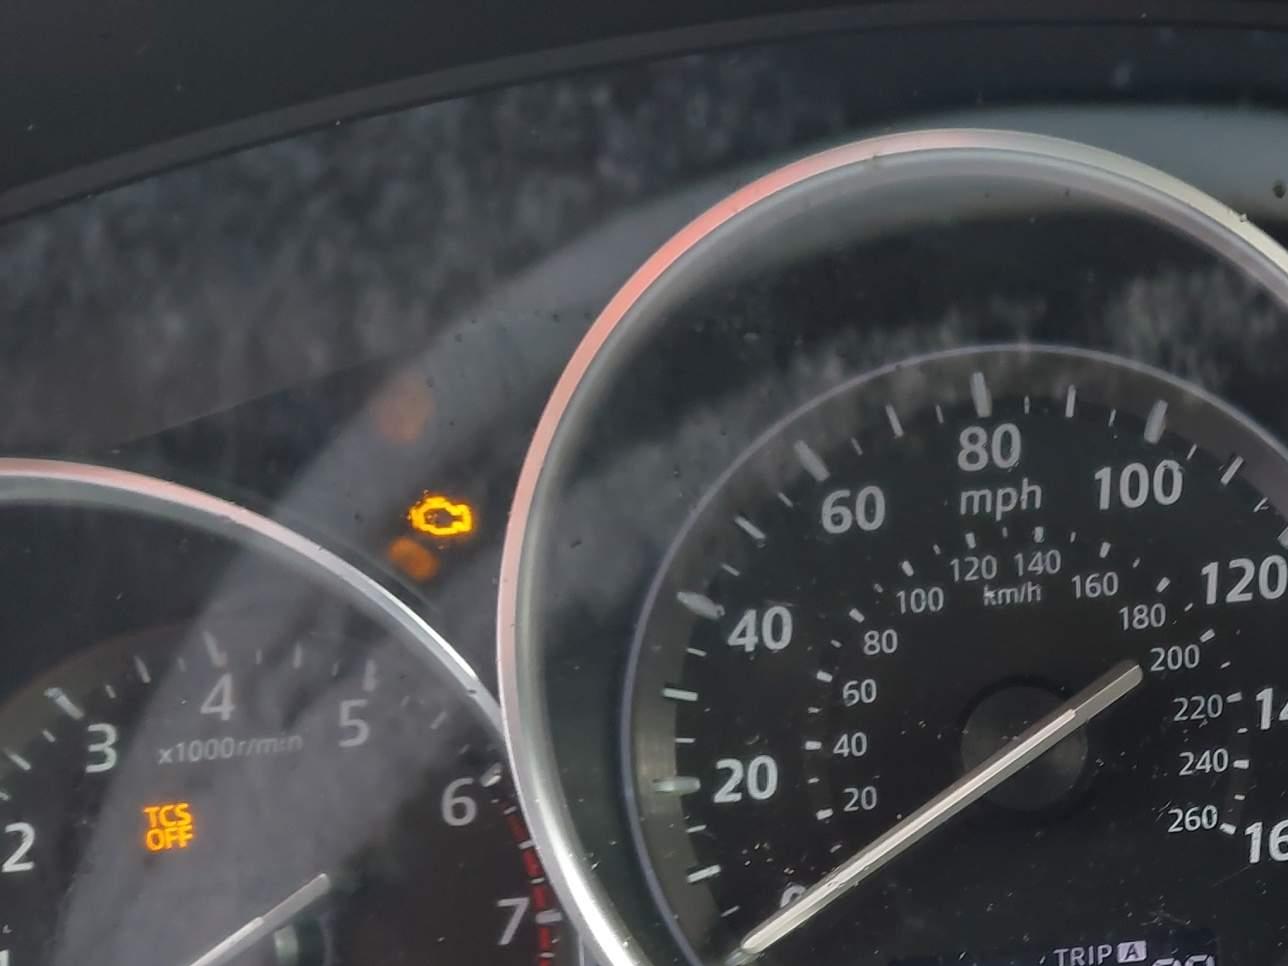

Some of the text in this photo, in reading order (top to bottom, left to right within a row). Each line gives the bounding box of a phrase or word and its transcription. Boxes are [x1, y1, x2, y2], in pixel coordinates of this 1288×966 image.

[957, 422, 1022, 472] 80
[960, 477, 1042, 521] mph
[1094, 459, 1183, 510] 100
[821, 485, 886, 534] 60
[950, 555, 998, 582] 120
[1014, 549, 1062, 577] 140
[983, 581, 1041, 606] km/h
[1071, 571, 1119, 599] 160
[1201, 554, 1288, 605] 120
[896, 586, 945, 614] 100
[727, 605, 793, 652] 40
[1118, 603, 1166, 631] 180
[863, 628, 899, 656] 80
[1149, 644, 1200, 672] 200
[200, 673, 235, 721] 4
[842, 679, 877, 706] 60
[1173, 693, 1224, 723] 220
[337, 698, 371, 748] 5
[84, 722, 118, 773] 3
[832, 731, 868, 758] 40
[1178, 748, 1229, 776] 240
[713, 754, 779, 803] 20
[441, 777, 477, 826] 6
[843, 786, 878, 812] 20
[144, 803, 192, 827] TCS
[1166, 804, 1219, 833] 260
[1, 821, 36, 872] 2
[145, 825, 193, 851] OFF
[497, 896, 530, 945] 7
